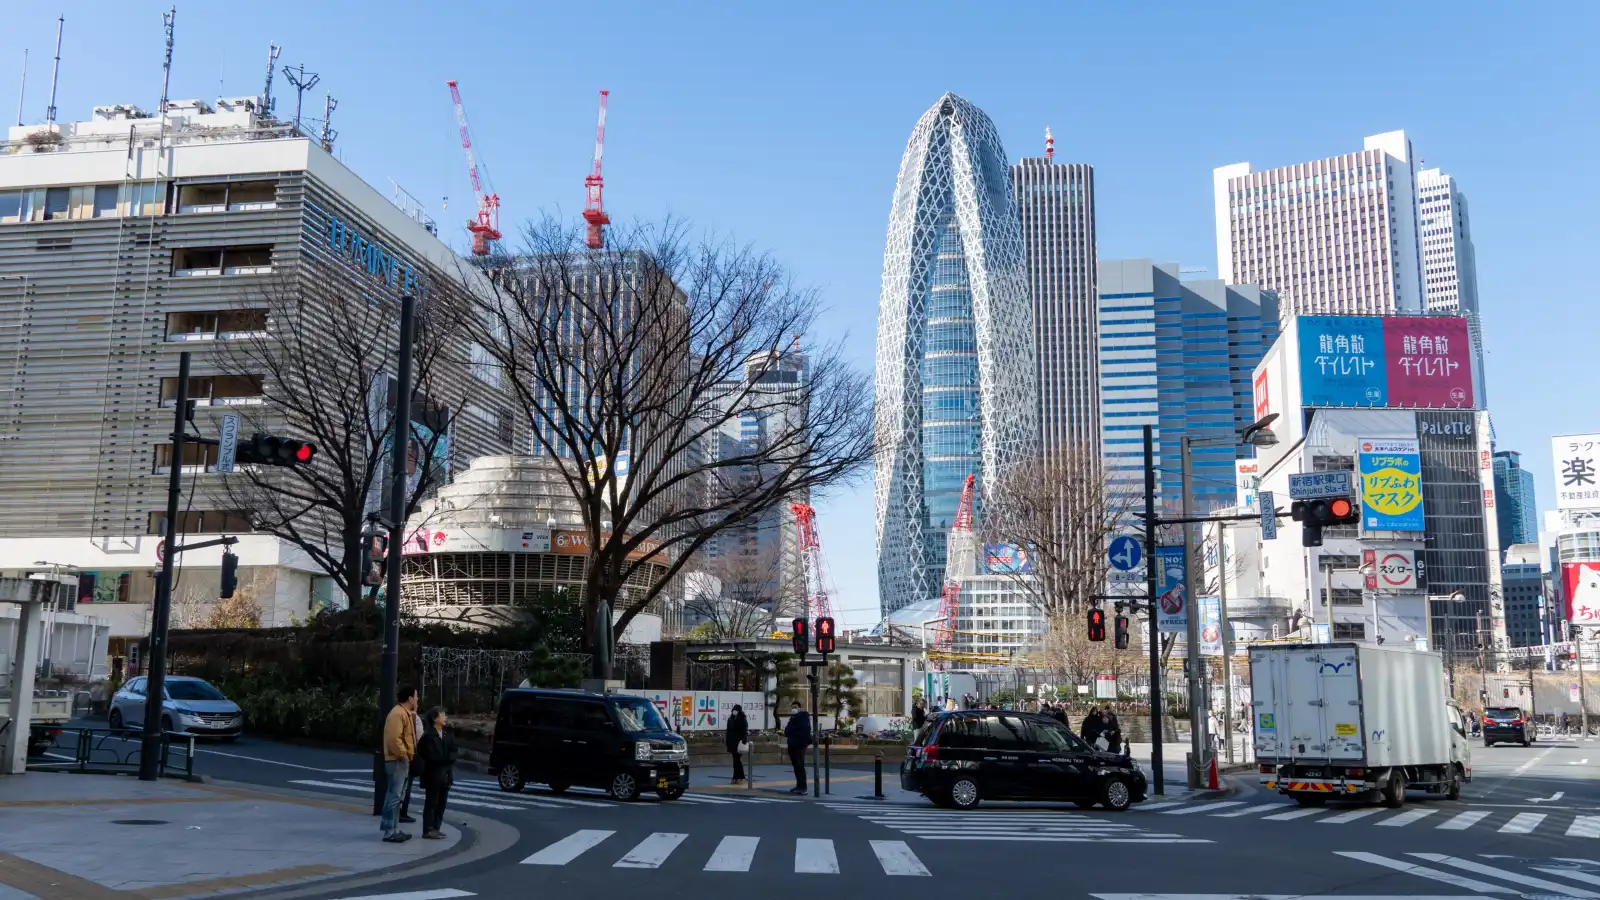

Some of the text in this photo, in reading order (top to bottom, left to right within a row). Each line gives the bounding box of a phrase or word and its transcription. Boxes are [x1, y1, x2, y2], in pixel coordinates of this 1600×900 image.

[331, 215, 398, 288] LUMINE
[1319, 334, 1365, 354] 龍角散
[1403, 335, 1449, 355] 龍角散
[1562, 456, 1596, 486] 楽
[1291, 474, 1347, 487] 新宿駅東口
[1369, 476, 1415, 489] リブふわ
[1291, 488, 1323, 496] Shinjuku
[1369, 491, 1415, 507] マスク
[1262, 493, 1274, 538] スクランブル式
[1380, 565, 1413, 574] スシロー
